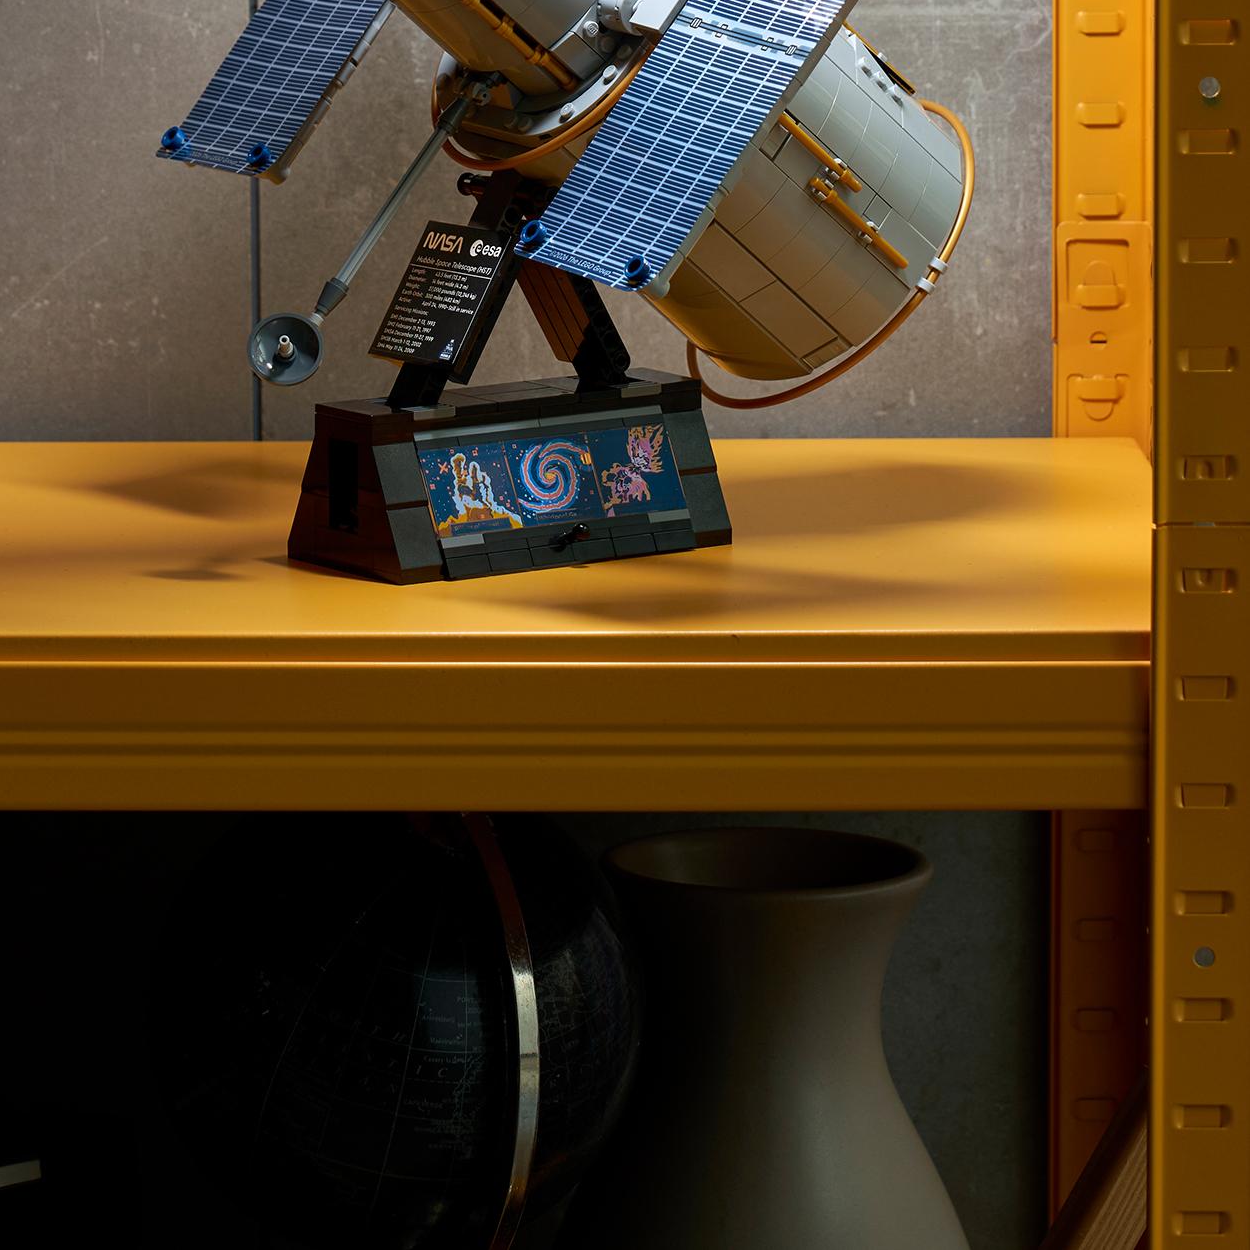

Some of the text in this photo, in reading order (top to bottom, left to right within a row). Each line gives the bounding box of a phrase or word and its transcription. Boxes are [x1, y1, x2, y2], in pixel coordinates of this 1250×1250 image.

[423, 231, 463, 253] NASA
[417, 255, 492, 275] Hubble Space Telescope (HST)
[567, 256, 579, 264] The
[578, 259, 594, 269] LEGO
